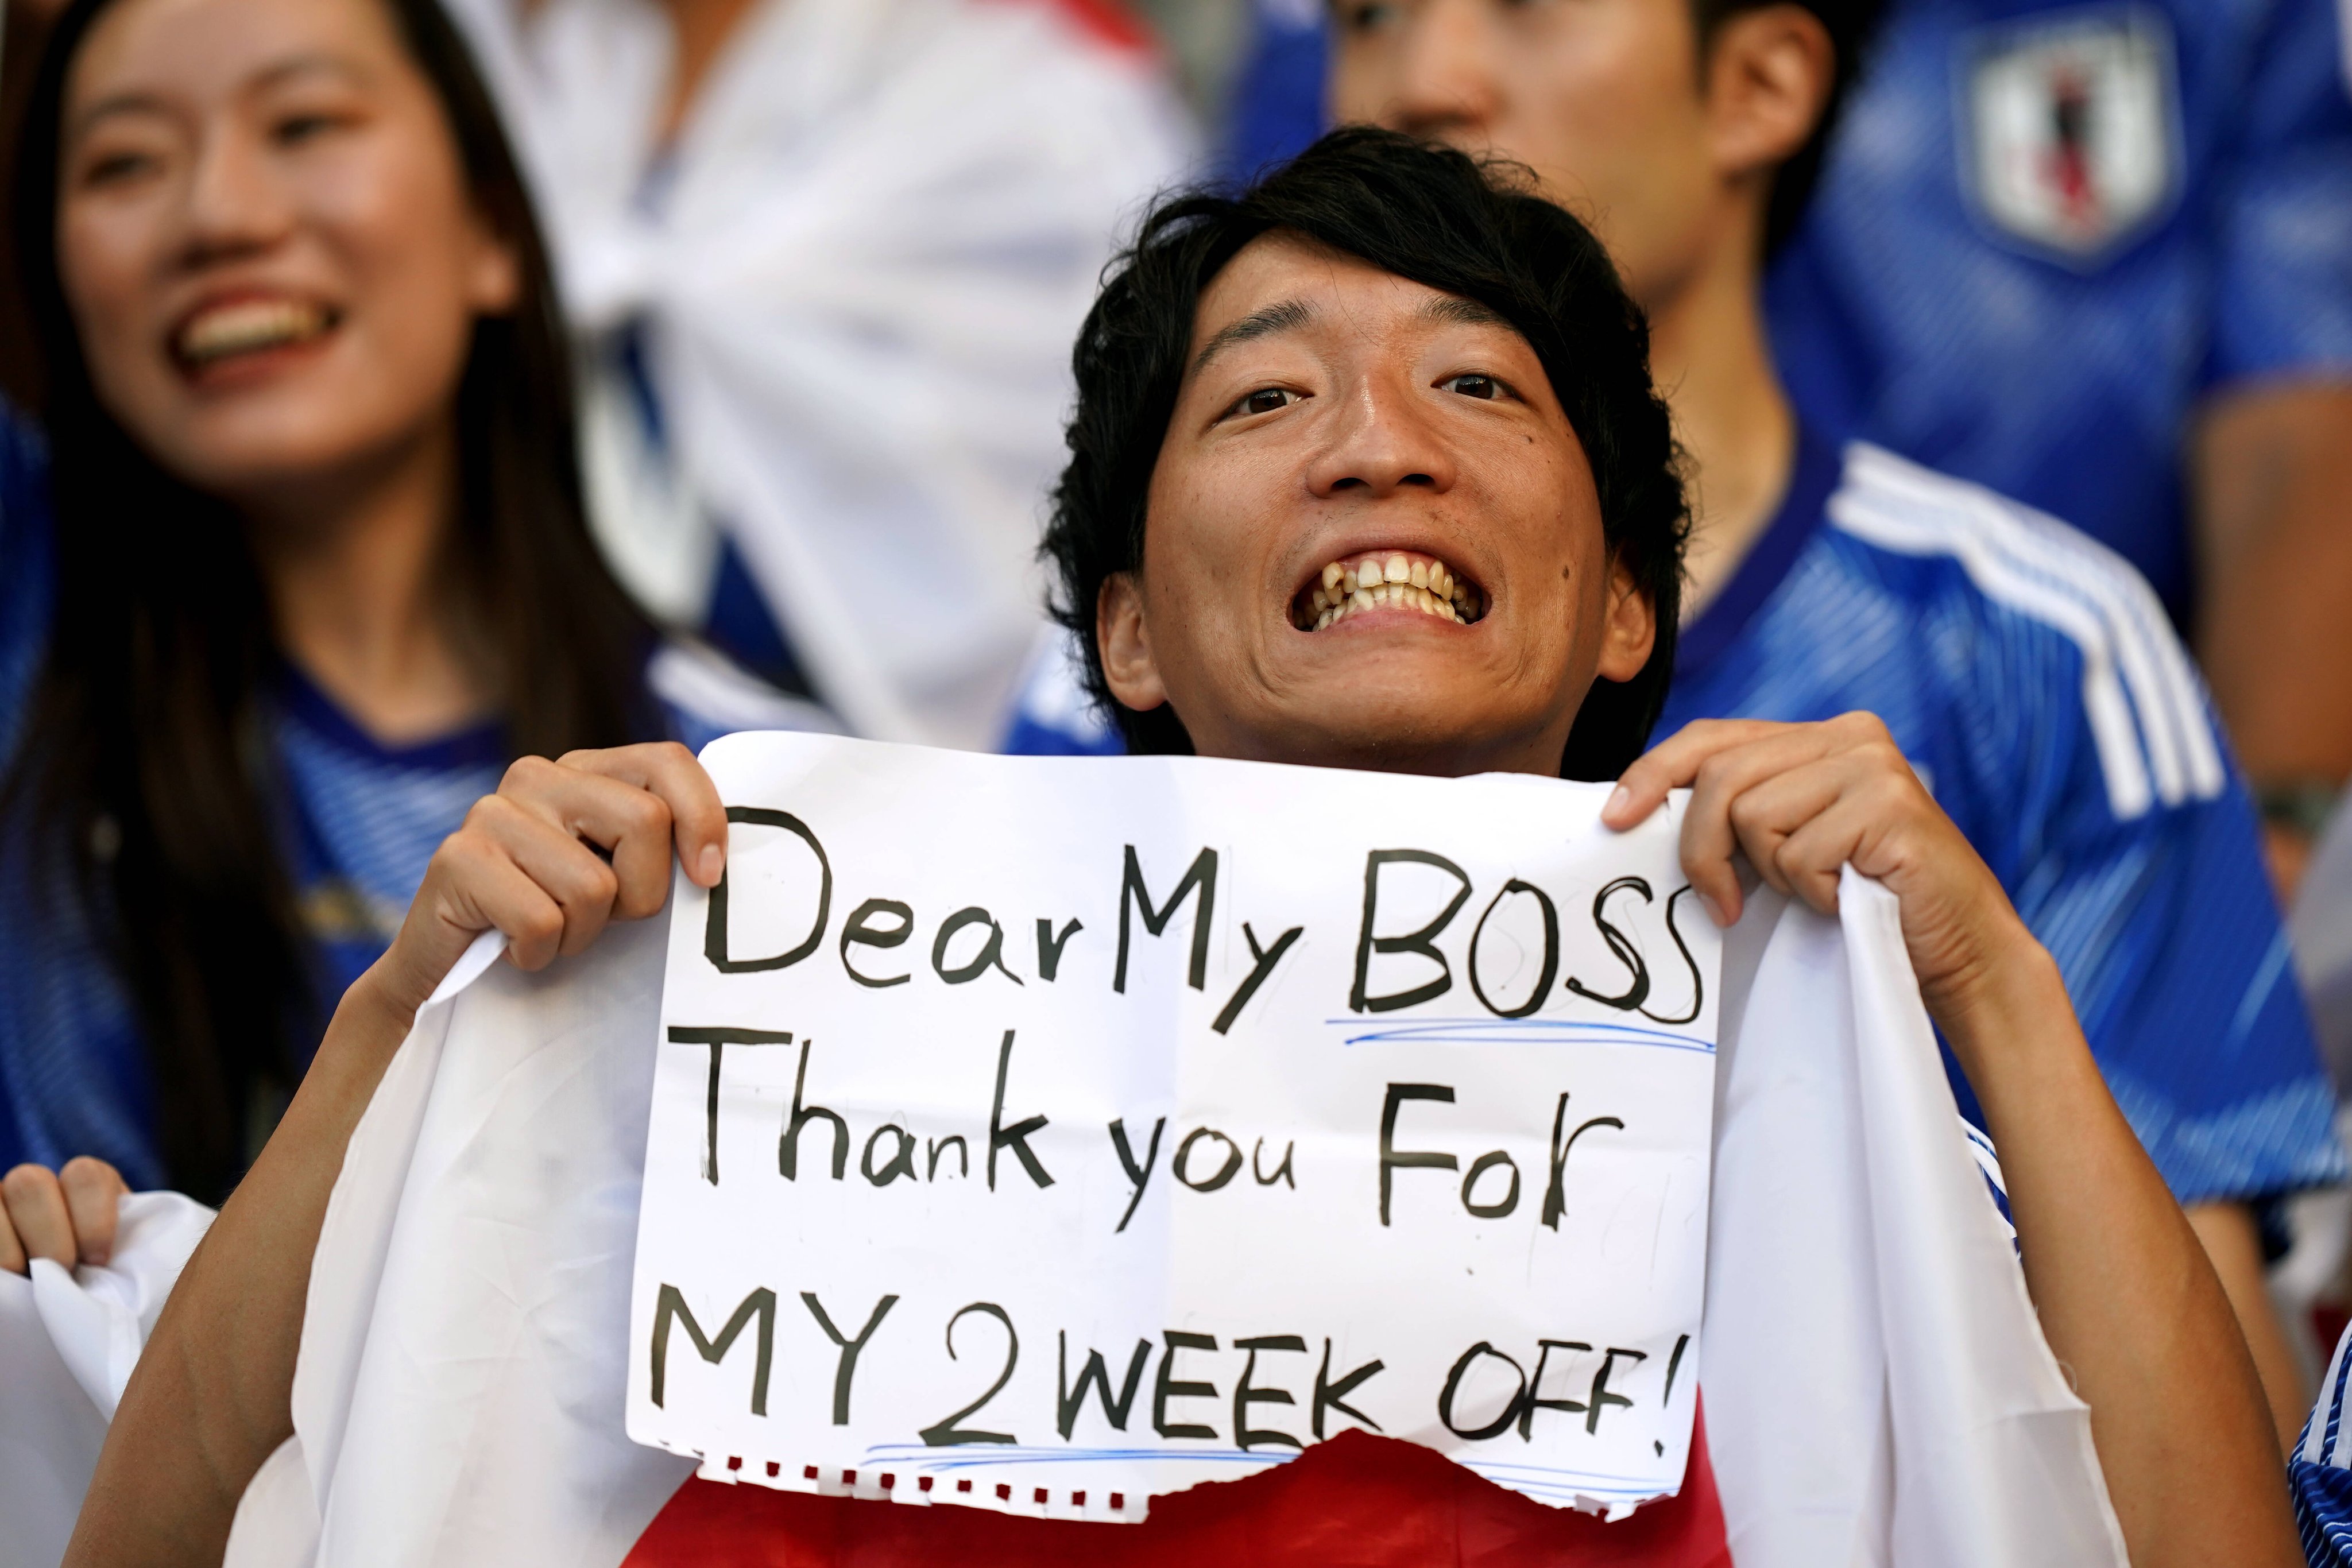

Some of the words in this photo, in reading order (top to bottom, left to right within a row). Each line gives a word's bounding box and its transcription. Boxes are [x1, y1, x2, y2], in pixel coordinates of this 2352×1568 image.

[705, 806, 1083, 988] Dear
[1114, 844, 1303, 1035] My
[1349, 849, 1703, 1024] BOSS
[668, 1026, 1056, 1193] Thank
[1109, 1116, 1296, 1233] you
[1378, 1083, 1624, 1232] For
[651, 1283, 900, 1426] MY
[918, 1302, 1018, 1446] 2
[1056, 1329, 1386, 1453] WEEK
[1439, 1334, 1690, 1457] OFF!
